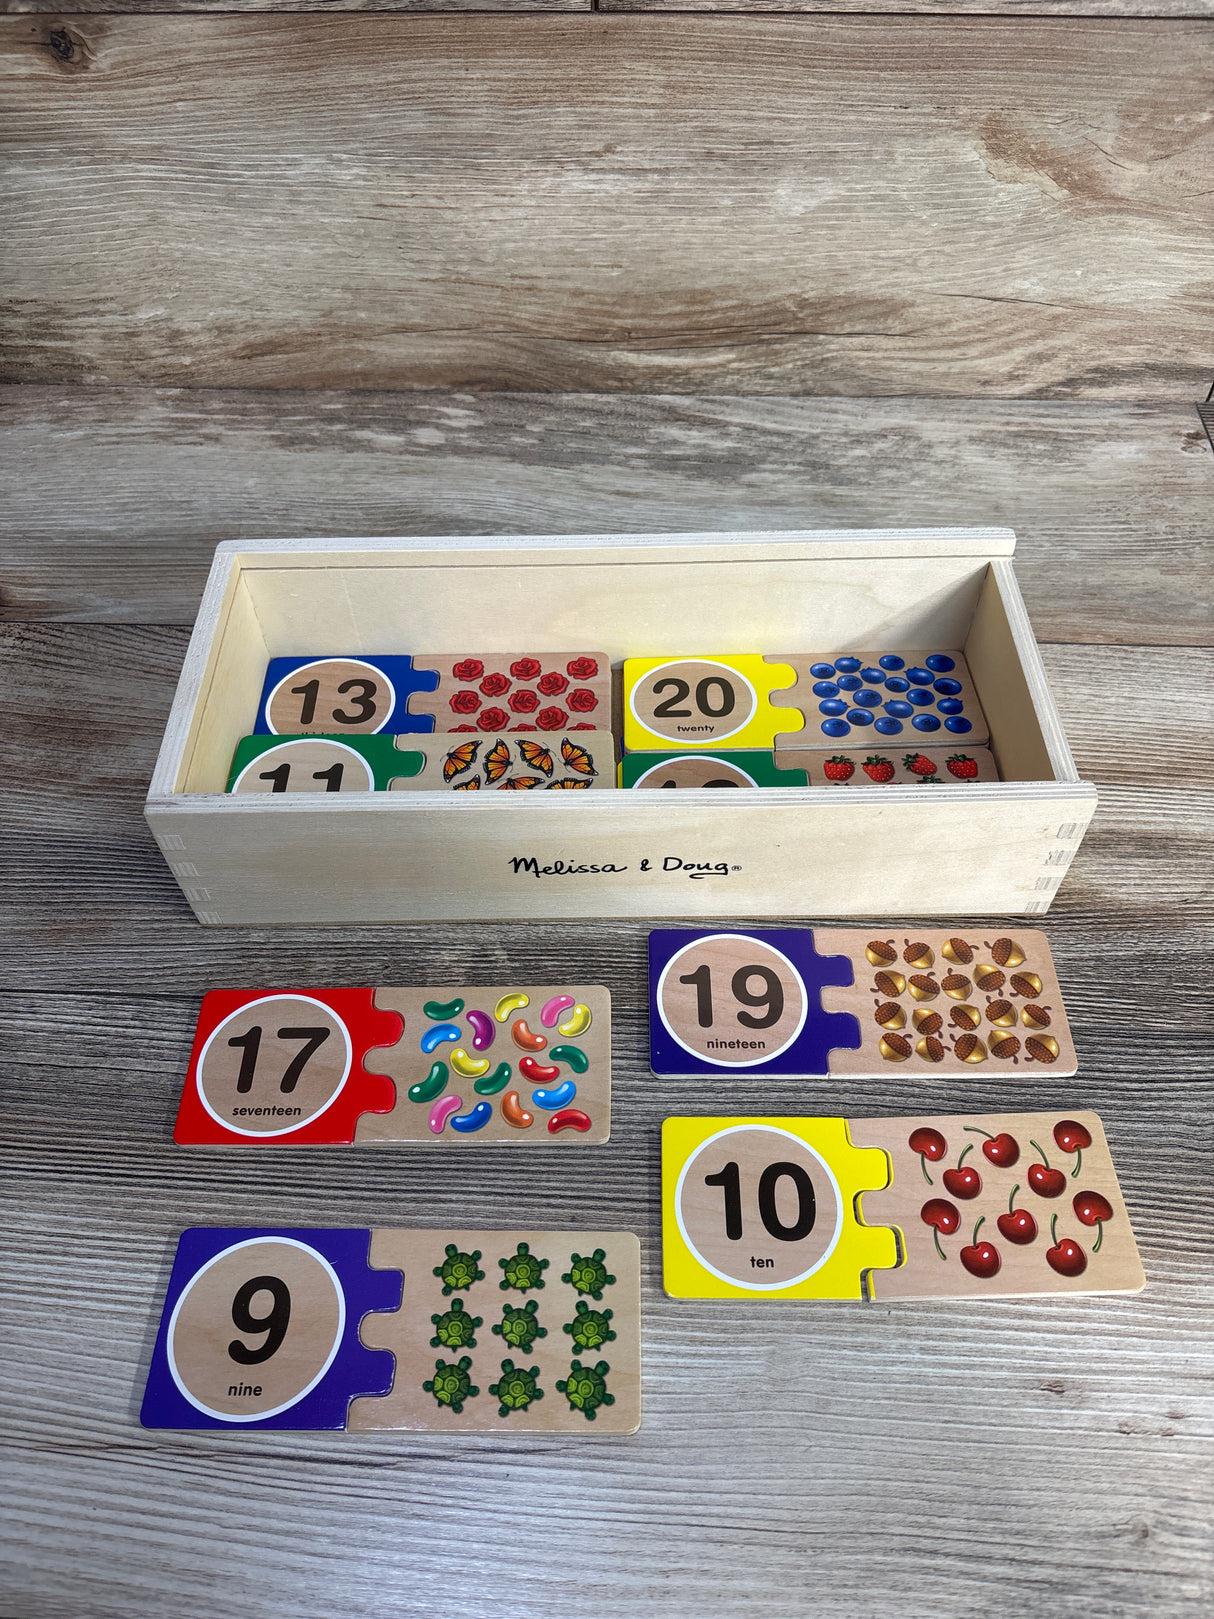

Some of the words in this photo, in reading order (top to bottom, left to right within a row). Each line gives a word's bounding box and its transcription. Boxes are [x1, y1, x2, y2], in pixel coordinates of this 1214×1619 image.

[291, 679, 377, 725] 13
[652, 676, 736, 718] 20
[677, 725, 715, 733] twenty
[508, 856, 628, 878] Melissa
[640, 859, 653, 872] &
[679, 964, 785, 1030] 19
[227, 1025, 331, 1094] 17
[706, 1038, 766, 1049] nineteen
[232, 1105, 302, 1116] seventeen
[704, 1161, 817, 1242] 10
[750, 1256, 775, 1268] ten
[228, 1275, 292, 1366] 9
[228, 1382, 263, 1397] nine
